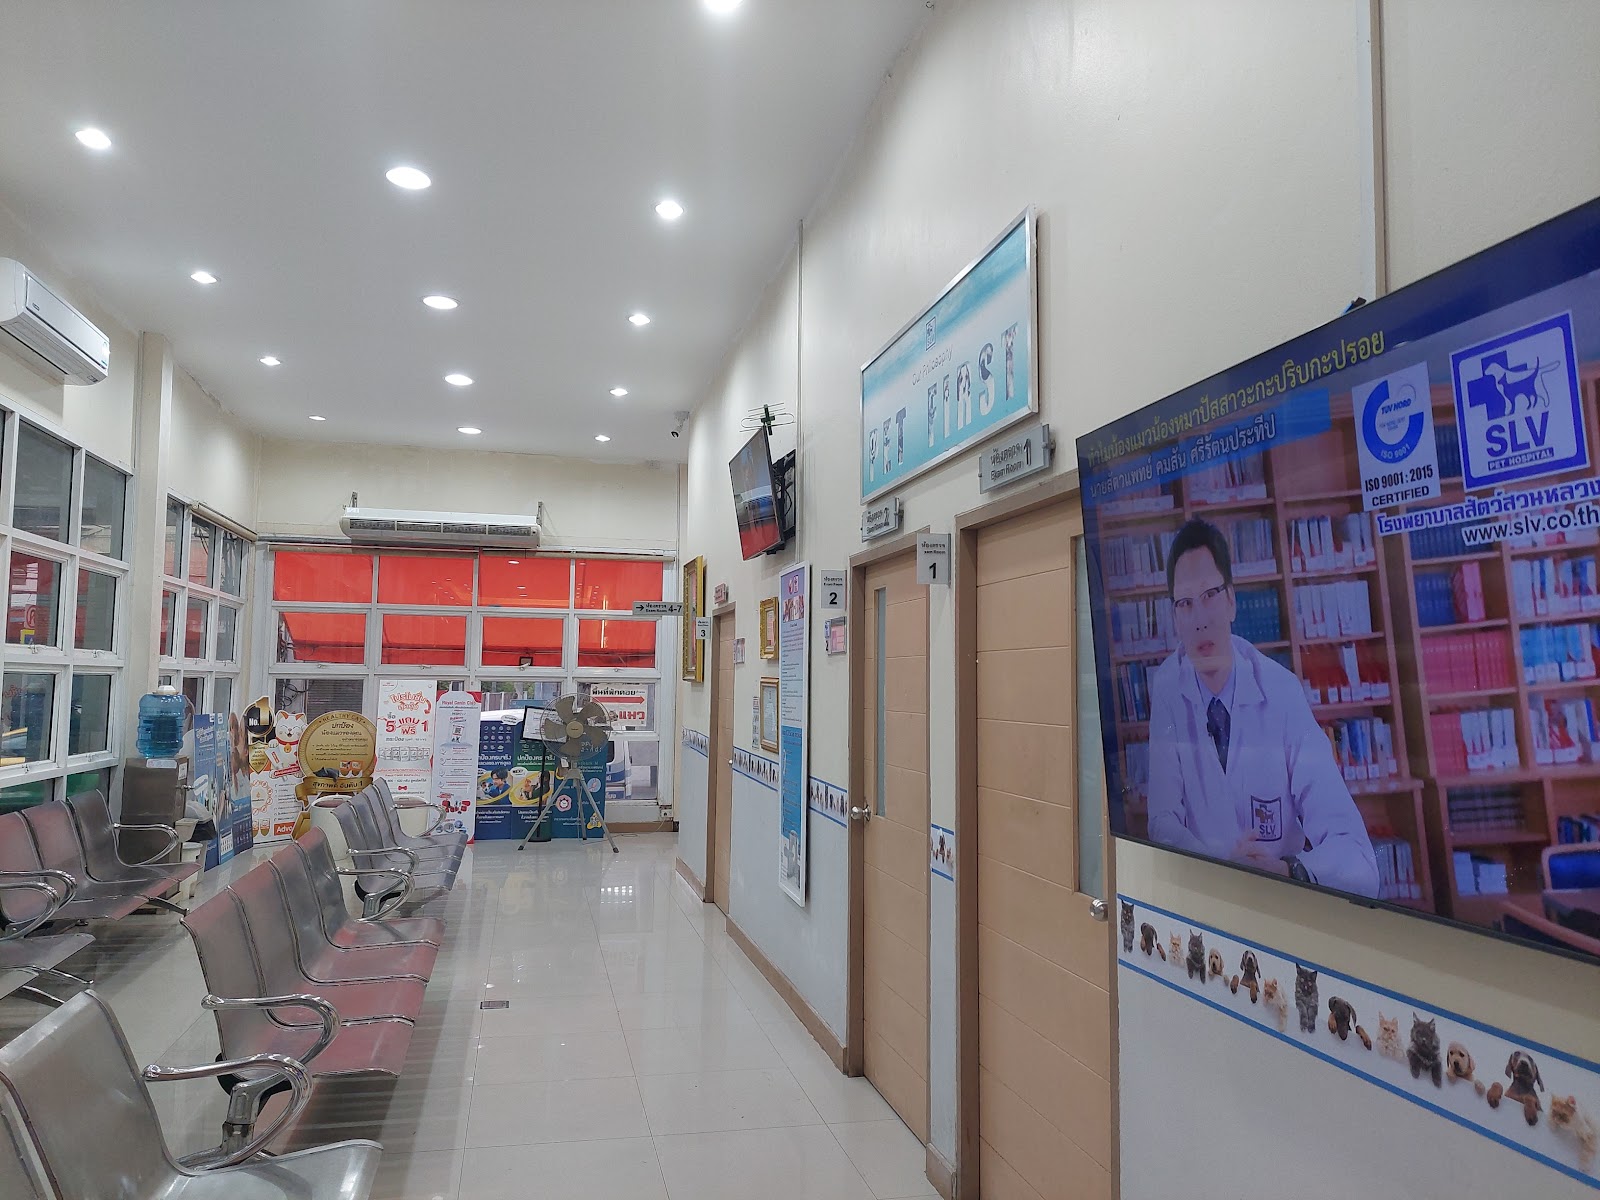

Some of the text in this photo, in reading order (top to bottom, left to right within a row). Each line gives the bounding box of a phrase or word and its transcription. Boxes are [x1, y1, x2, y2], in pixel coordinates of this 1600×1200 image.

[868, 322, 1018, 482] PET FIRST
[1486, 411, 1549, 457] SLV
[1024, 438, 1032, 466] 1
[1490, 449, 1553, 470] PET HOSPITAL
[1364, 477, 1380, 492] ISO
[1372, 486, 1430, 507] CERTIFIED
[1464, 506, 1599, 543] www.slv.co.th
[929, 562, 936, 579] 1
[829, 592, 838, 604] 2
[248, 718, 260, 726] No.
[618, 710, 646, 720] แมว
[386, 720, 395, 732] 5
[421, 720, 428, 732] 1
[1260, 824, 1276, 836] SLV
